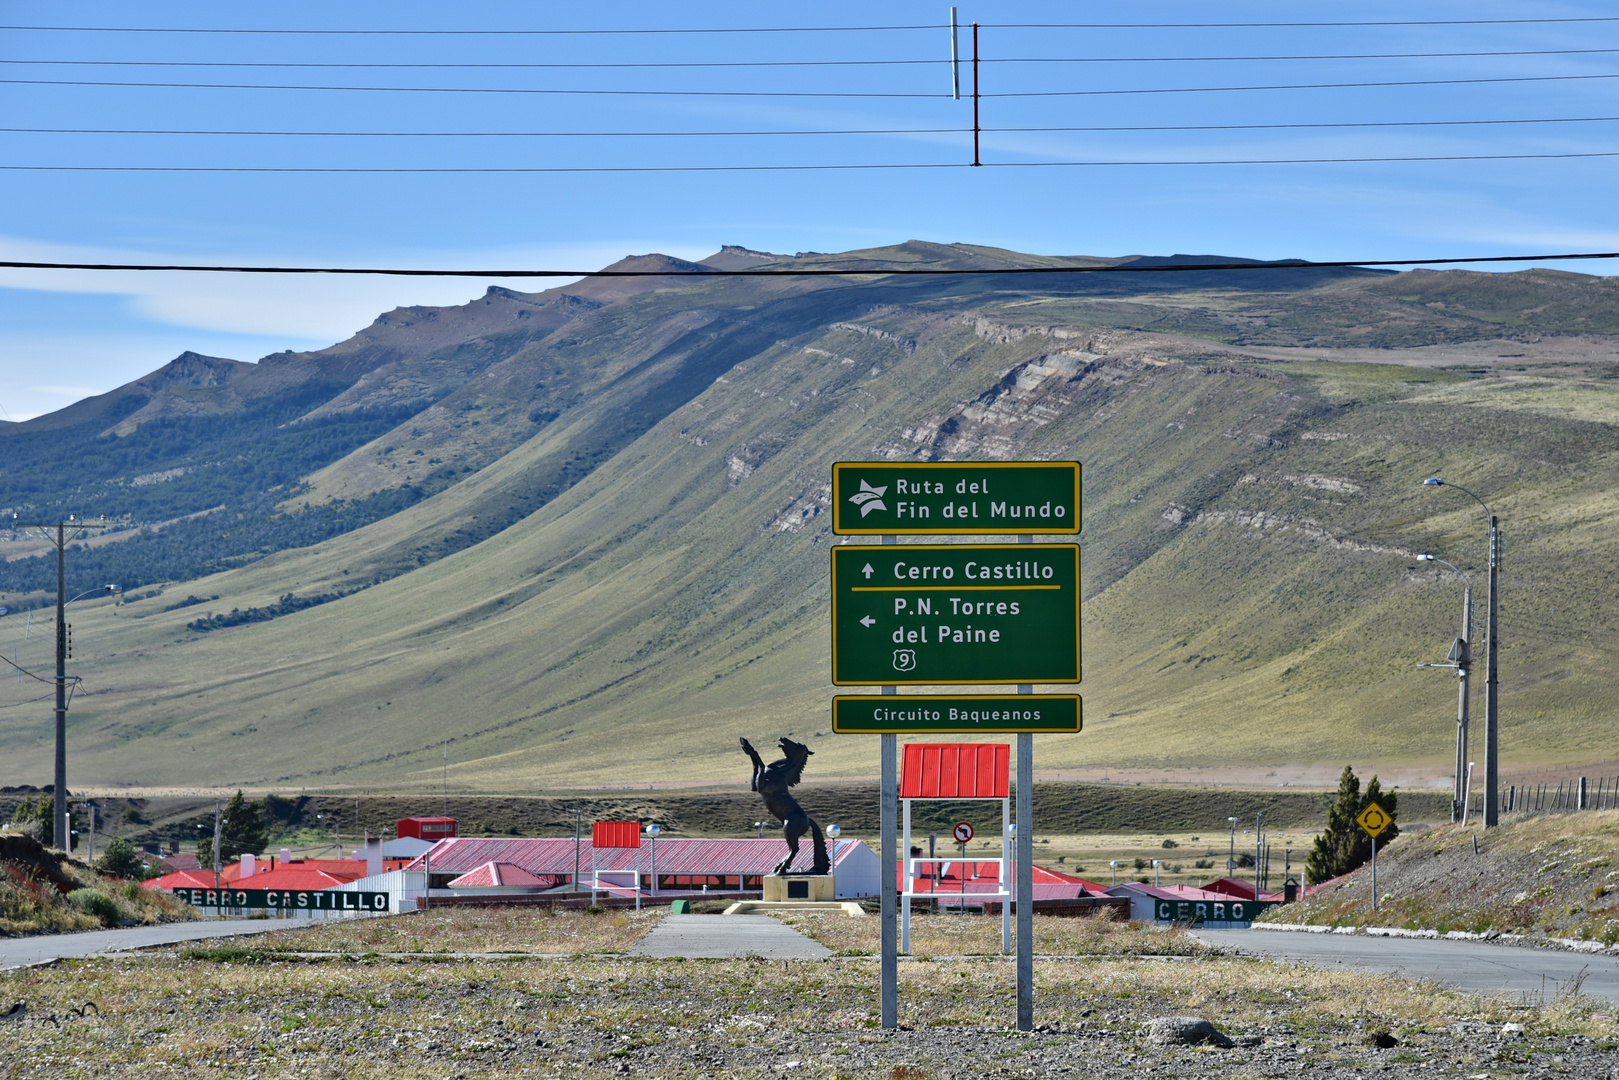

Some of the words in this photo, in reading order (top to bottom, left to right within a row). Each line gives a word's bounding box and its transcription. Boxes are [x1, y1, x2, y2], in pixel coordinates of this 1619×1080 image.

[896, 479, 944, 494] Ruta
[955, 478, 989, 494] del
[896, 501, 931, 518] Fin
[942, 501, 979, 518] del
[991, 501, 1066, 518] Mundo
[894, 561, 954, 579] Cerro
[965, 561, 1054, 579] Castillo
[894, 598, 940, 615] P.N.
[950, 597, 1020, 615] Torres
[892, 626, 928, 643] del
[938, 625, 1000, 643] Paine
[899, 653, 910, 667] 9
[873, 708, 941, 721] Circuito
[949, 708, 1041, 723] Baqueanos
[266, 891, 386, 910] CASTILLO
[1159, 902, 1244, 919] CERRO
